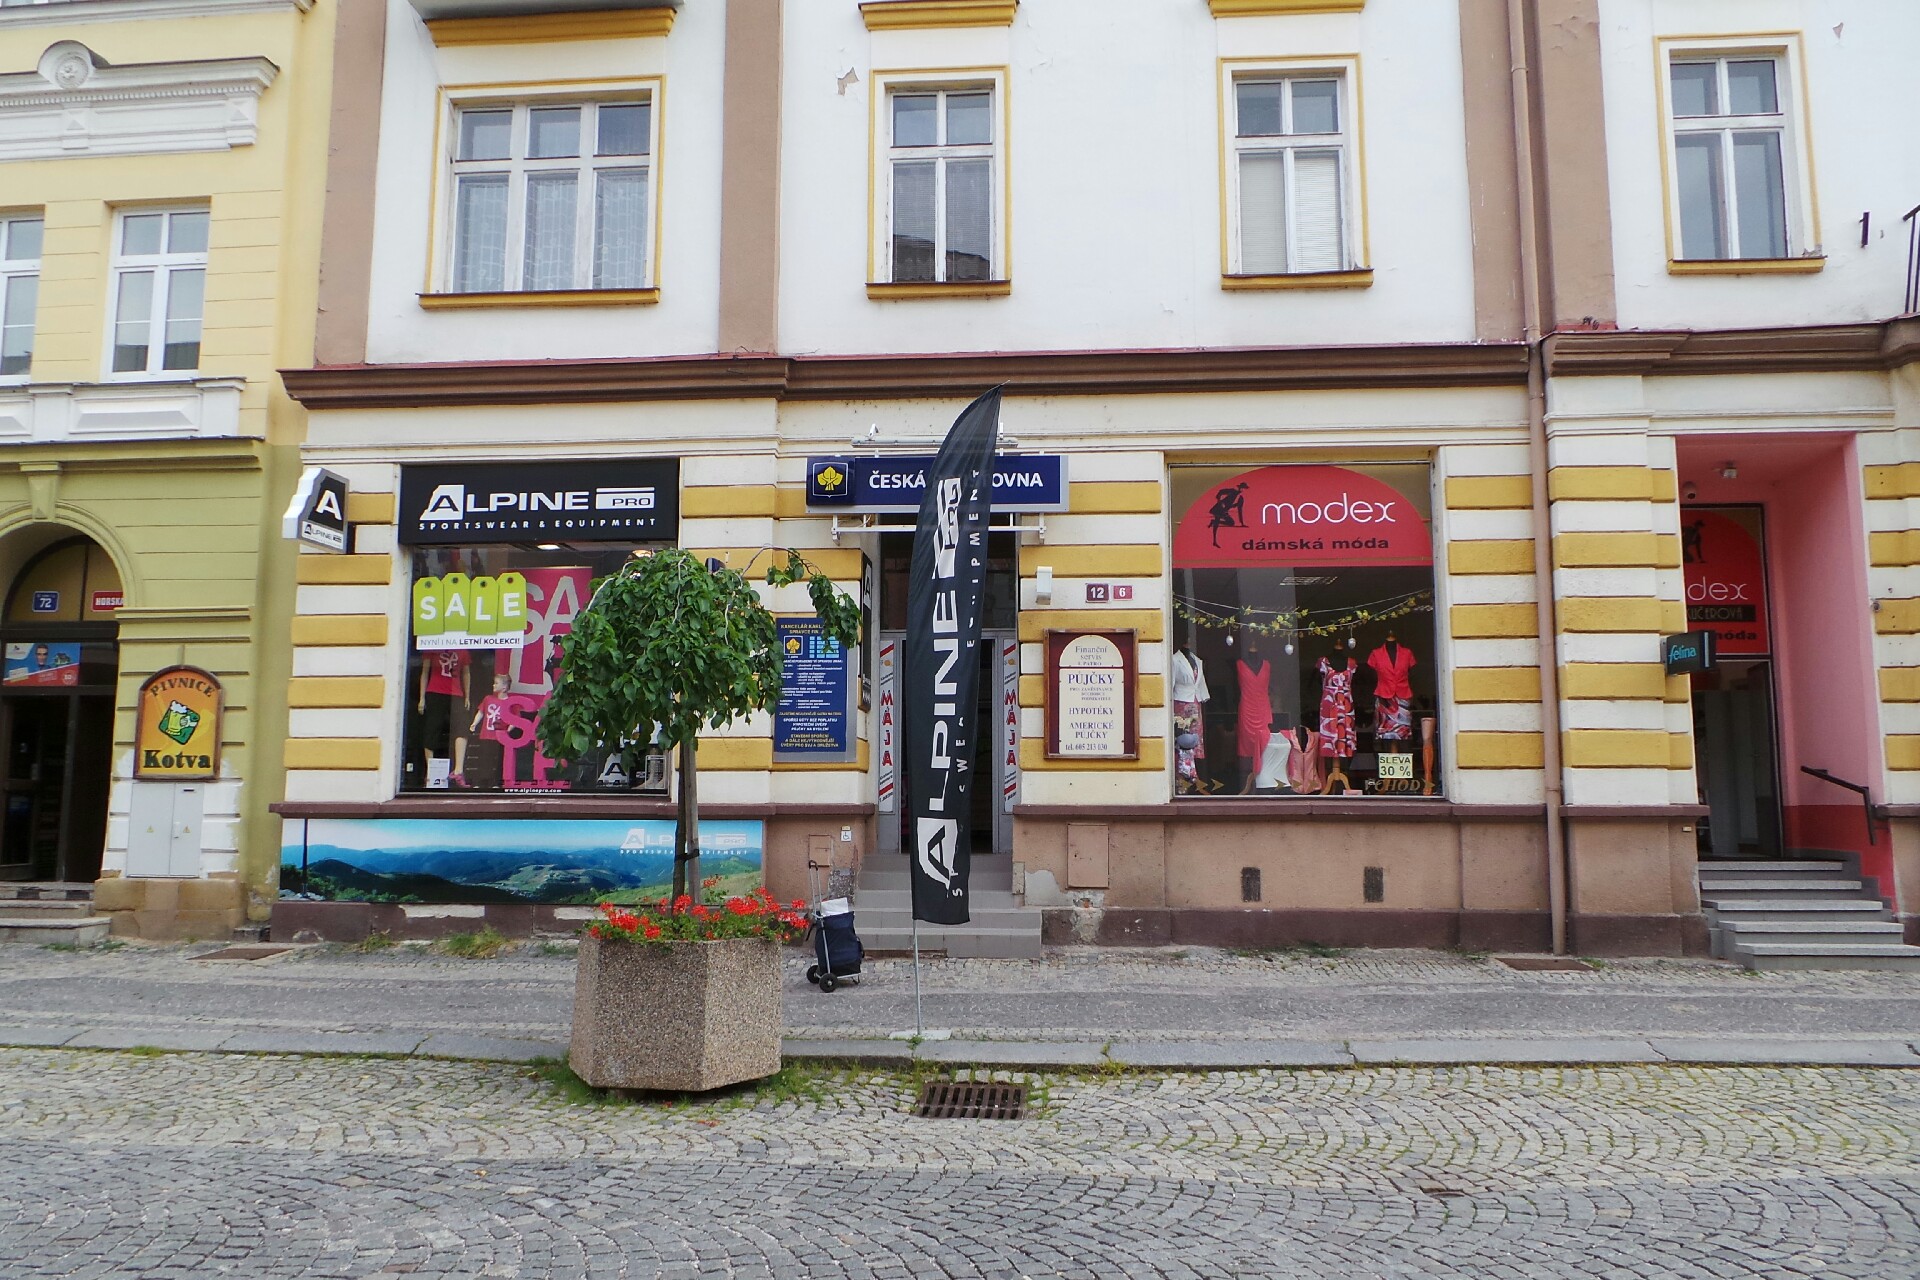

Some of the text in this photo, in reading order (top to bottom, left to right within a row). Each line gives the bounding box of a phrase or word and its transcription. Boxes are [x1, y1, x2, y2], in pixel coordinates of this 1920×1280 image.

[869, 470, 926, 489] ČESKÁ
[316, 490, 342, 520] A
[420, 485, 589, 520] ALPINE
[1262, 493, 1396, 525] modex
[419, 518, 656, 530] SPORTSWEAR & EQUIPMENT
[1242, 538, 1389, 550] dámská móda
[1091, 587, 1104, 599] 12
[1119, 588, 1126, 598] 6
[1687, 576, 1748, 601] dex
[40, 598, 51, 608] 72
[420, 592, 521, 621] SALE
[1668, 645, 1697, 664] felina
[150, 677, 216, 698] PIVNICE
[1069, 706, 1114, 715] HYPOTÉKY
[1069, 720, 1115, 729] AMERICKÉ
[917, 590, 958, 889] ALPINE
[143, 750, 211, 768] Kotva
[1380, 756, 1411, 764] SLEVA
[1380, 766, 1411, 776] 30 %
[620, 829, 711, 849] ALPE
